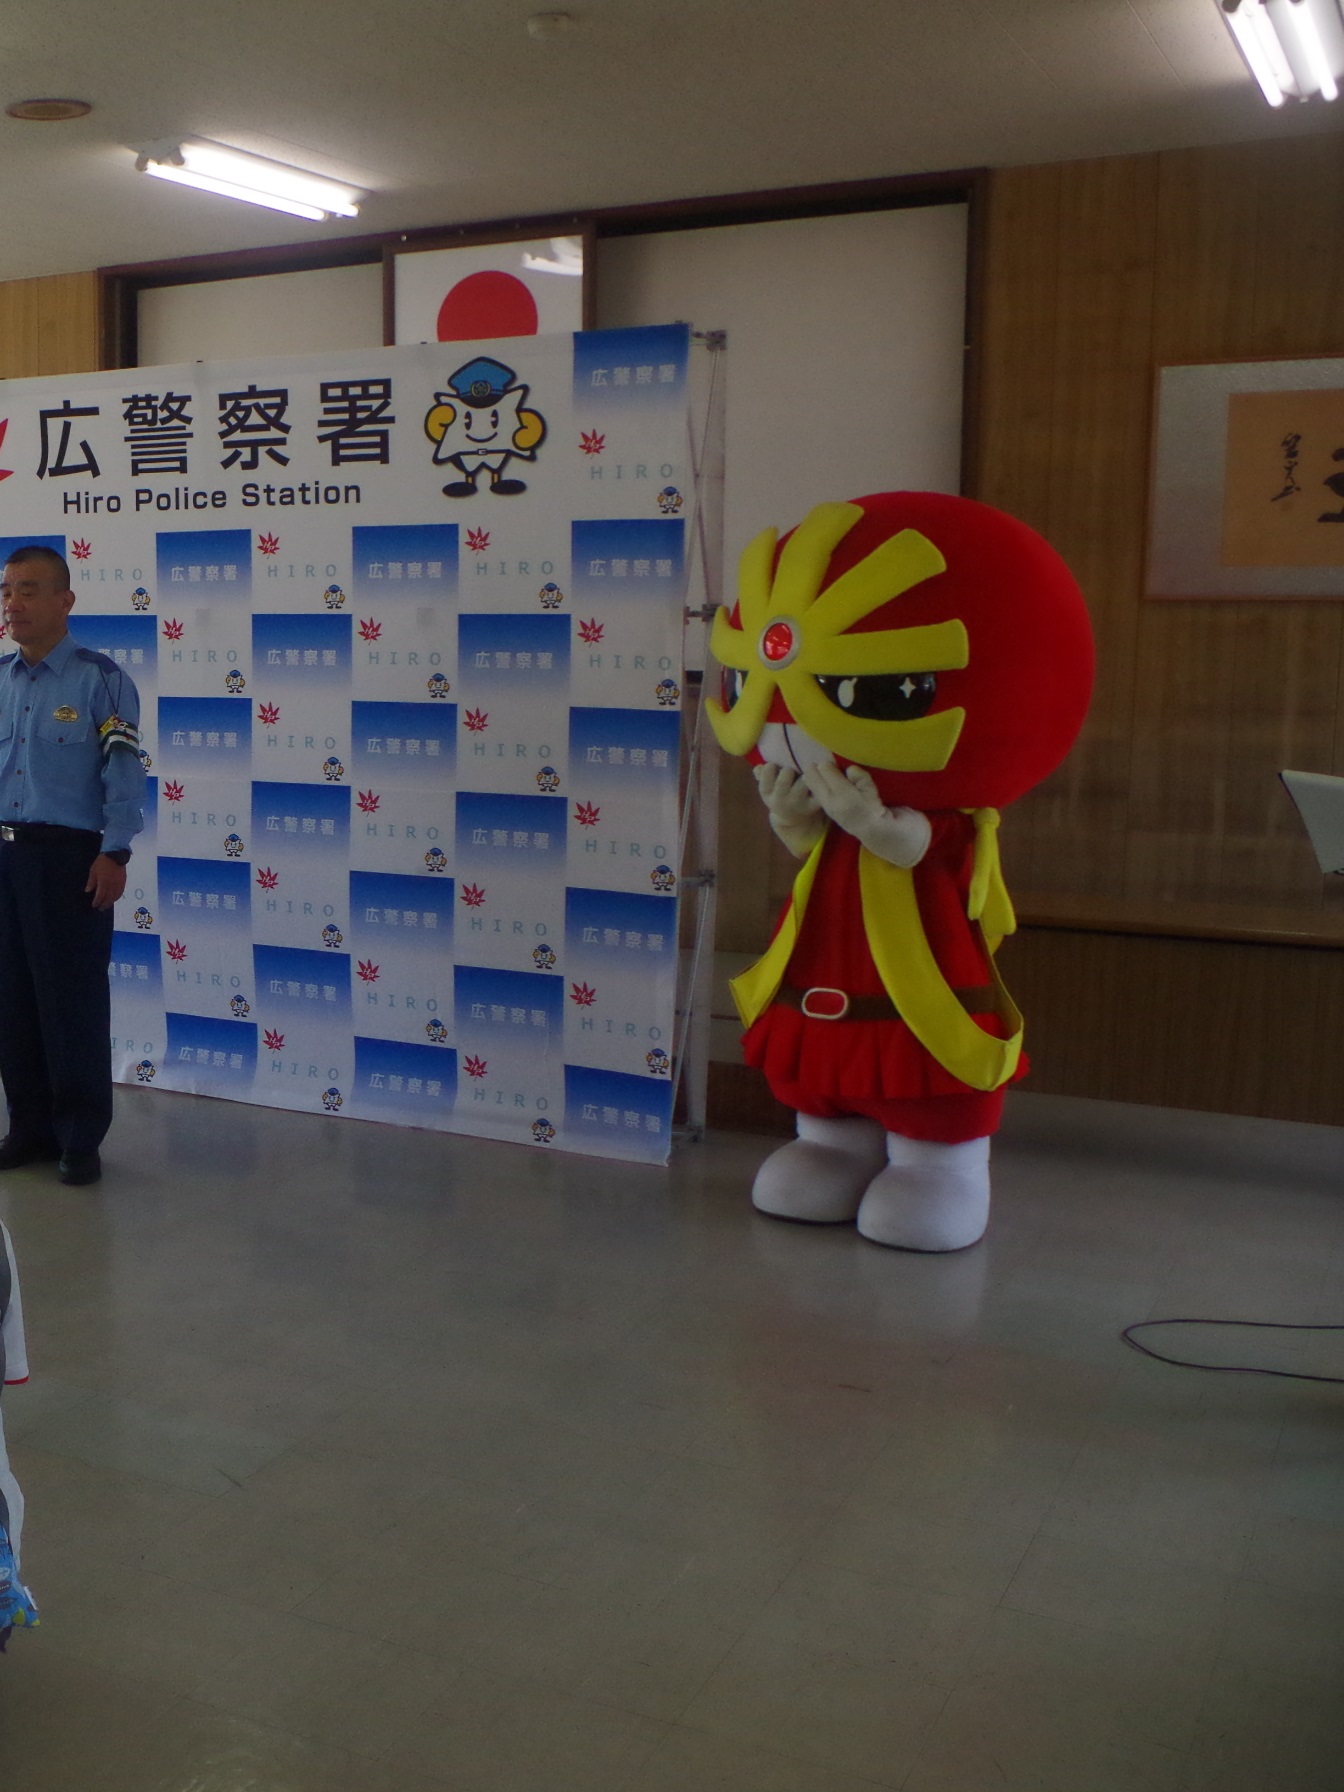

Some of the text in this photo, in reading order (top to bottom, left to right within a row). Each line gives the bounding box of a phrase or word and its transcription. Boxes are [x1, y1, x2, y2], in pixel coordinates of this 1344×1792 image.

[591, 364, 676, 386] 広警察署
[36, 378, 395, 480] 広警察署
[591, 464, 673, 480] HIRO
[63, 481, 361, 514] Hiro Police Station
[81, 568, 142, 582] HIRO
[171, 565, 237, 582] 広警察署
[268, 564, 337, 577] HIRO
[368, 562, 442, 579] 広警察署
[476, 561, 554, 575] HIRO
[589, 560, 672, 577] 広警察署
[172, 649, 238, 663] HIRO
[267, 650, 336, 665] 広警察署
[368, 652, 441, 665] HIRO
[476, 652, 553, 669] 広警察署
[589, 654, 671, 670] HIRO
[172, 731, 237, 748] 広警察署
[268, 735, 336, 749] HIRO
[367, 737, 440, 755] 広警察署
[474, 742, 551, 759] HIRO
[587, 747, 668, 767] 広警察署
[172, 812, 236, 826] HIRO
[266, 816, 335, 835] 広警察署
[367, 823, 439, 840] HIRO
[472, 829, 549, 849] 広警察署
[585, 839, 666, 859] HIRO
[172, 890, 237, 910] 広警察署
[267, 900, 334, 917] HIRO
[365, 907, 438, 929] 広警察署
[472, 918, 547, 936] HIRO
[583, 928, 663, 951] 広警察署
[177, 970, 241, 987] HIRO
[270, 979, 336, 1001] 広警察署
[367, 992, 438, 1011] HIRO
[472, 1004, 547, 1027] 広警察署
[582, 1017, 661, 1040] HIRO
[111, 1038, 154, 1053] IRO
[178, 1046, 243, 1069] 広警察署
[272, 1060, 339, 1080] HIRO
[369, 1072, 442, 1096] 広警察署
[474, 1088, 548, 1110] HIRO
[582, 1104, 661, 1132] 広警察署
